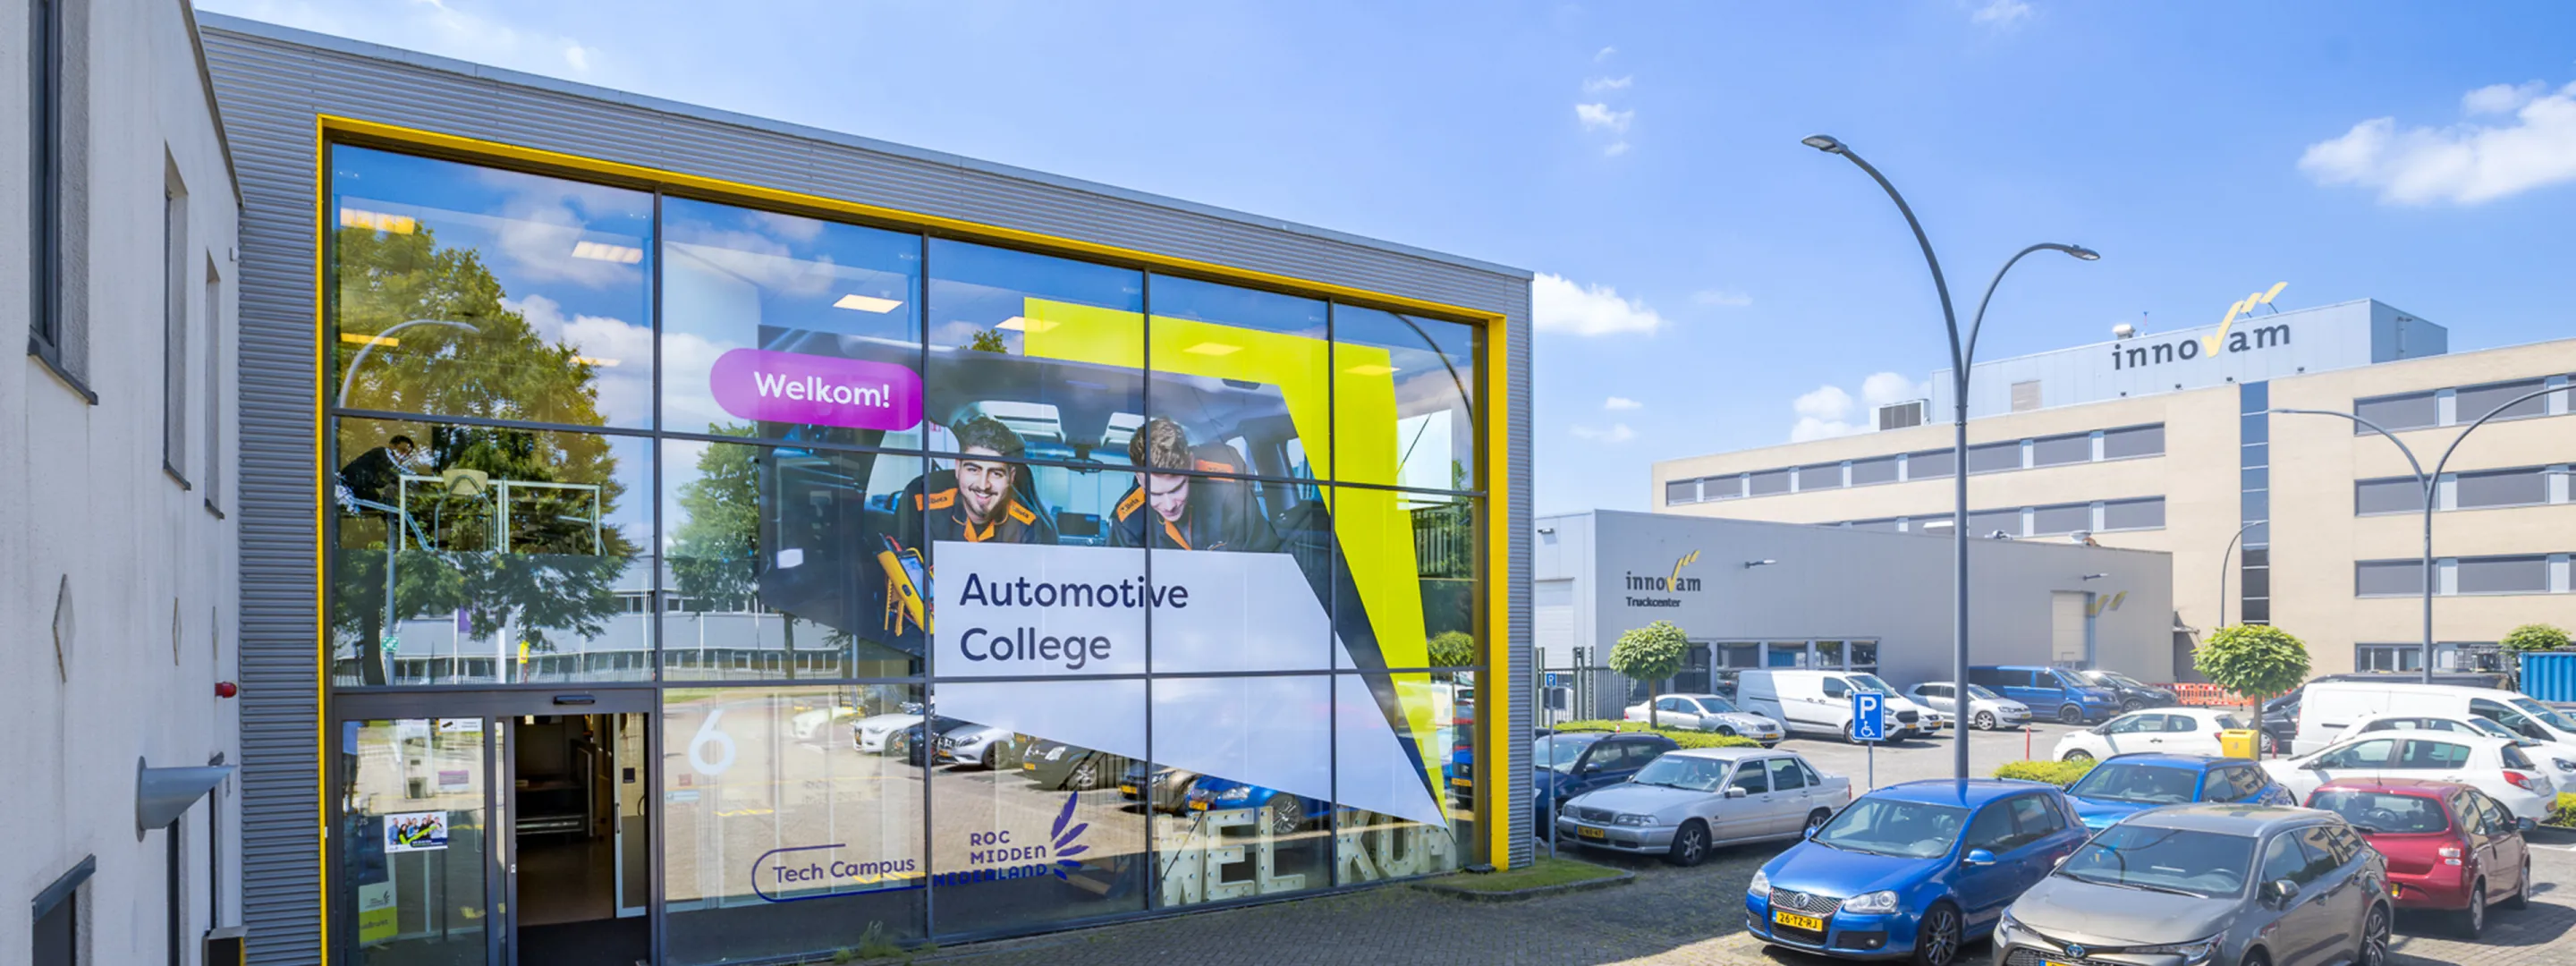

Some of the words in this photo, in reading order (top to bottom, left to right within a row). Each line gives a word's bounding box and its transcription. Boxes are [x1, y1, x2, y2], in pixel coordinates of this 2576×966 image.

[2112, 301, 2290, 370] innovam
[754, 371, 890, 408] Welkom!
[1626, 559, 1701, 592] innovam
[959, 572, 1189, 608] Automotive
[1626, 597, 1682, 607] Truckcenter
[960, 626, 1112, 670] College
[1860, 696, 1877, 720] P
[689, 709, 735, 775] 6
[970, 830, 1011, 846] ROC
[970, 845, 1046, 864] MIDDEN
[773, 863, 824, 883] Tech
[830, 859, 915, 877] Campus
[932, 863, 1047, 887] NEDERLAND
[1779, 912, 1818, 928] 26-TZ-RJ
